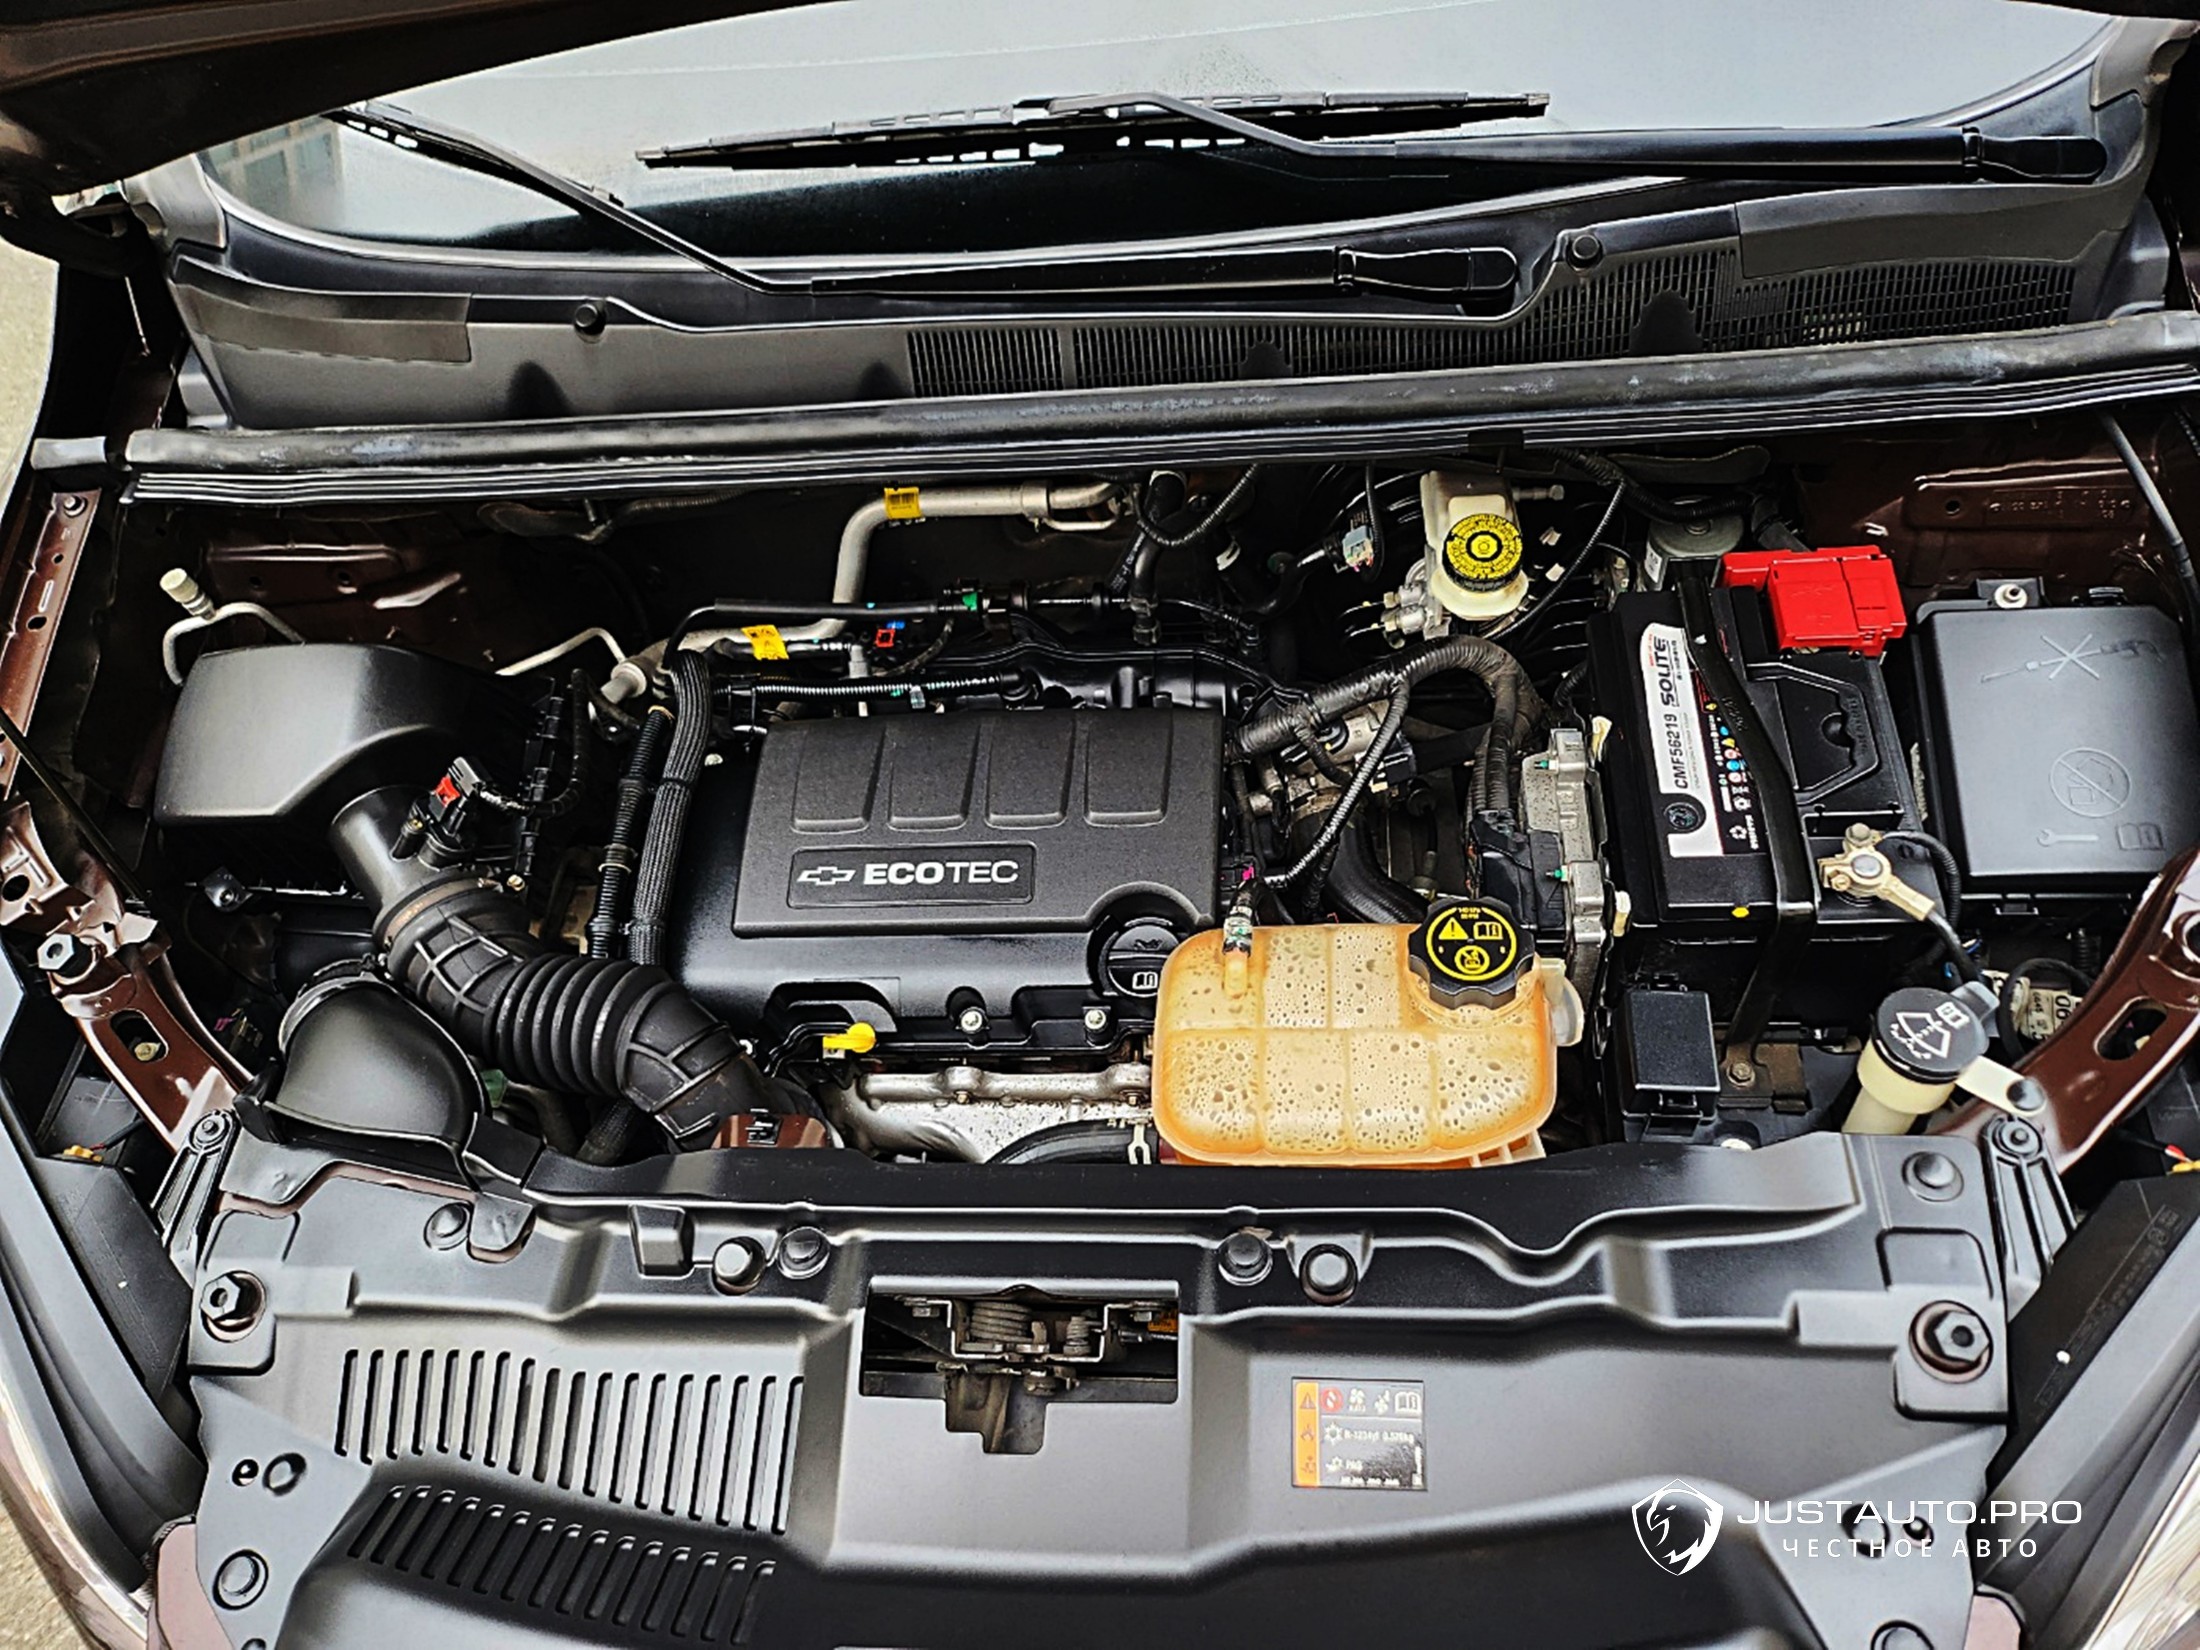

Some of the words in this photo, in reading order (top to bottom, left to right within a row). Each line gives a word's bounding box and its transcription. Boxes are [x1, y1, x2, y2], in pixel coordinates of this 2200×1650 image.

[1654, 635, 1675, 707] SOLITE
[1664, 713, 1689, 790] CMF56219
[863, 859, 1019, 885] ECOTEC
